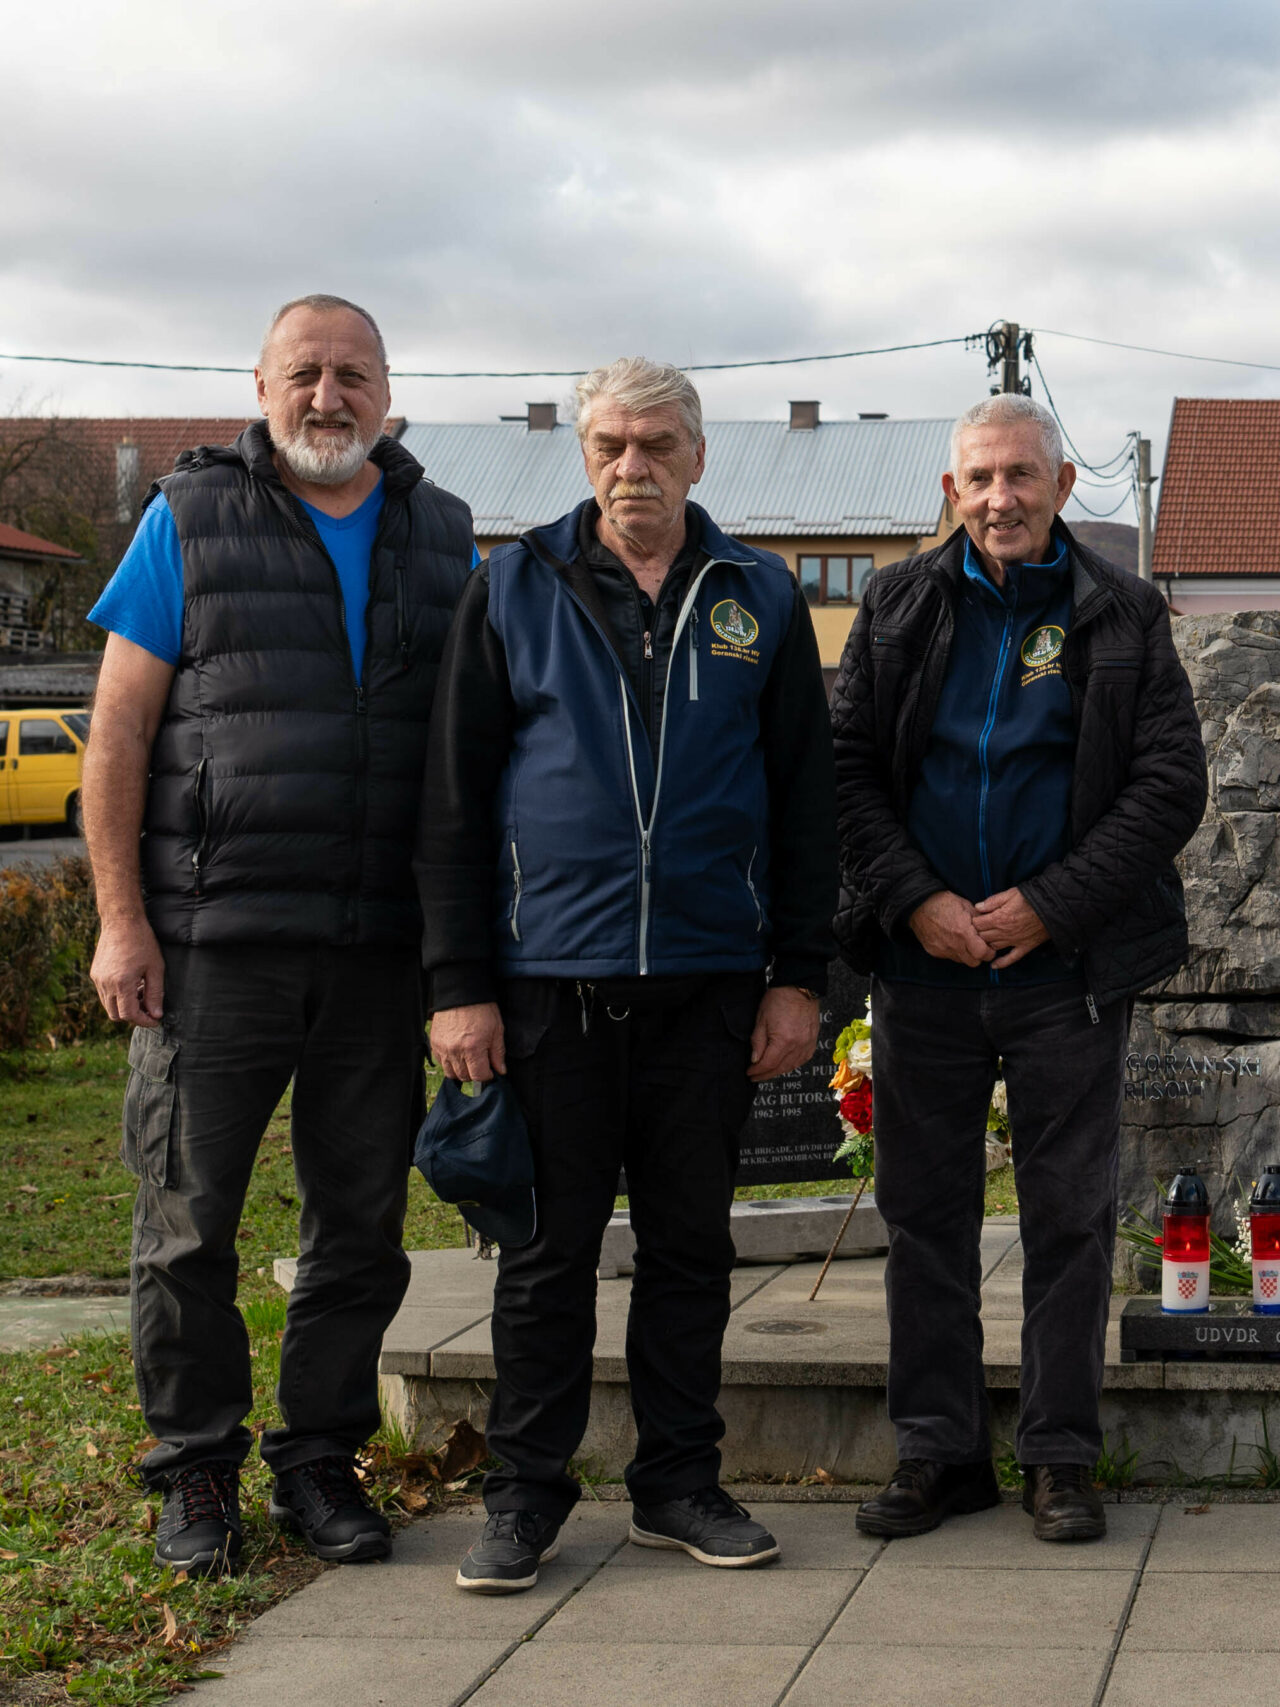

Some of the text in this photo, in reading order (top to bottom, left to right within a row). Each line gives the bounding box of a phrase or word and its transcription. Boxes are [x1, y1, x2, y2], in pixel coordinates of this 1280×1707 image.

[711, 642, 728, 650] Klub
[711, 649, 742, 659] Goranski
[812, 1065, 838, 1076] PUH
[1125, 1052, 1262, 1078] GORANSKI
[758, 1082, 774, 1092] 973
[782, 1081, 802, 1091] 1995
[1122, 1080, 1206, 1102] RISOVI
[754, 1108, 774, 1119] 1962
[782, 1107, 802, 1118] 1995
[1195, 1326, 1260, 1344] UDVDR
